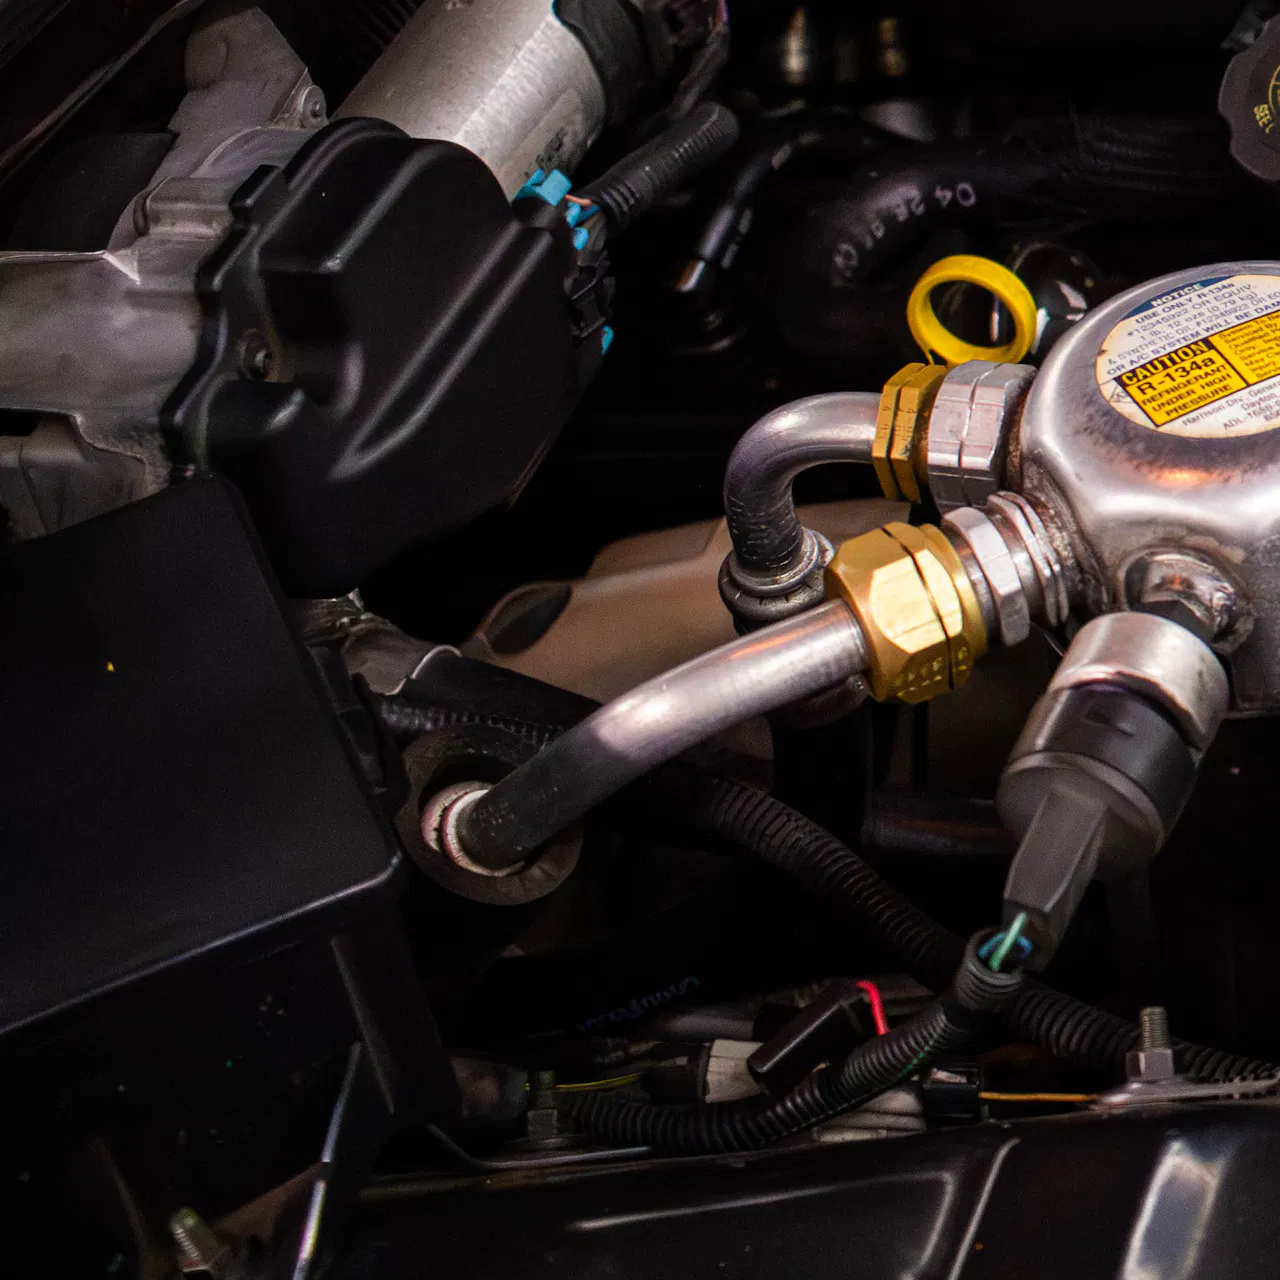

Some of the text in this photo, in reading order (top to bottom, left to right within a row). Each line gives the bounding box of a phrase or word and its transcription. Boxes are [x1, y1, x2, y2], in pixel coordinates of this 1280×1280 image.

[1135, 311, 1157, 323] USE
[1161, 297, 1192, 312] ONLY
[1151, 284, 1202, 306] NOTICE
[1106, 364, 1125, 374] OR
[1129, 353, 1148, 365] A/C
[1151, 330, 1201, 354] SYSTEM
[1202, 319, 1230, 332] WILL
[1234, 311, 1249, 320] BE
[1118, 342, 1209, 385] CAUTION
[1136, 357, 1215, 394] R-134a
[1141, 364, 1225, 405] REFRIGERANT
[1152, 373, 1231, 411] UNDER HIGH
[1165, 384, 1229, 416] PRESSURE
